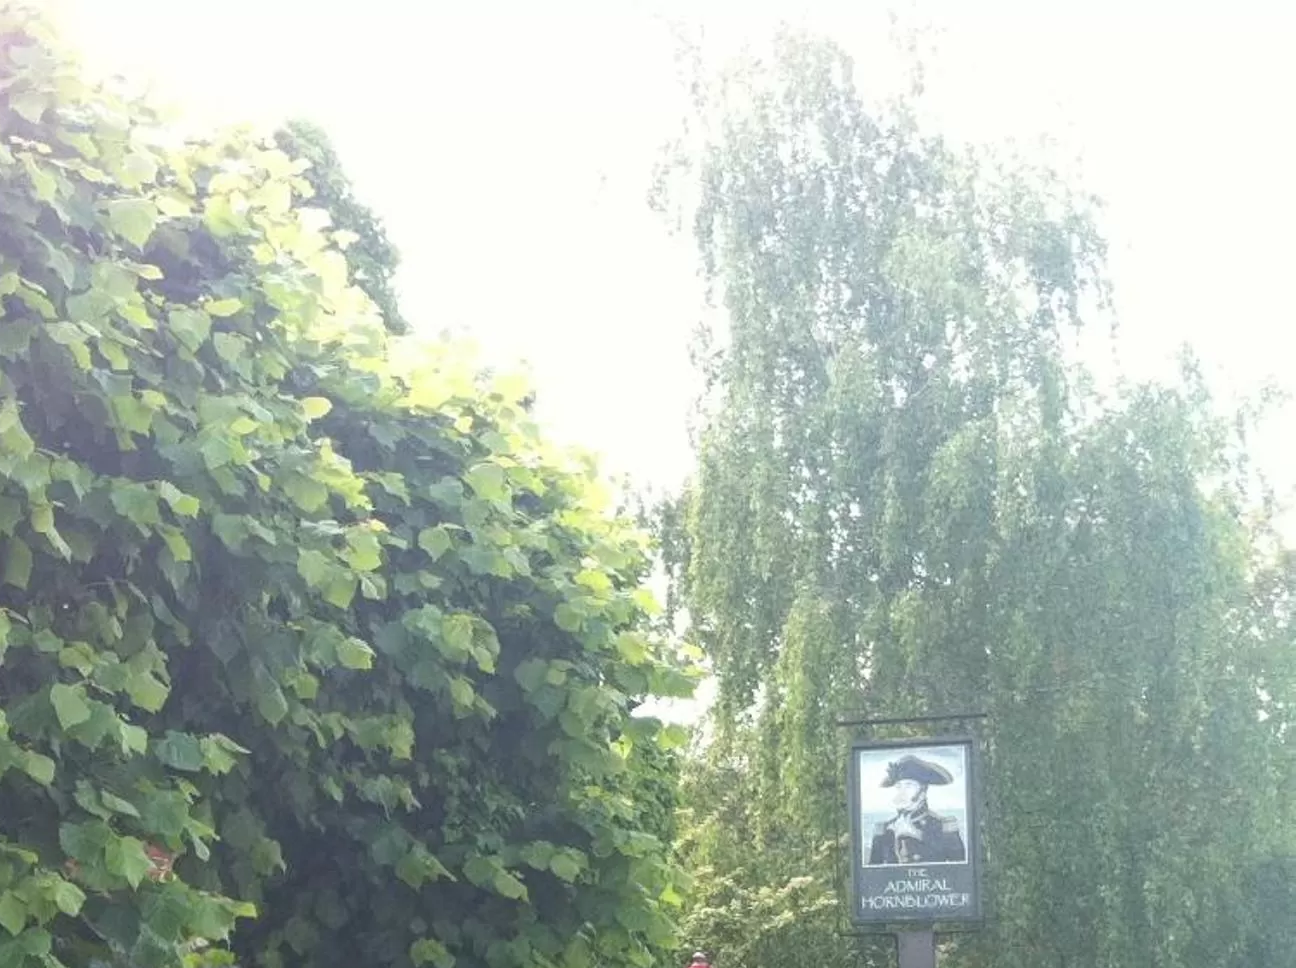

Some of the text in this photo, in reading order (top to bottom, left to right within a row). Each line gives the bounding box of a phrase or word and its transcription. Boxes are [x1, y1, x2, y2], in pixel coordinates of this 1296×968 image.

[907, 868, 927, 877] THE
[883, 879, 952, 893] ADMIRAL
[861, 892, 971, 910] HORNBLOWER
